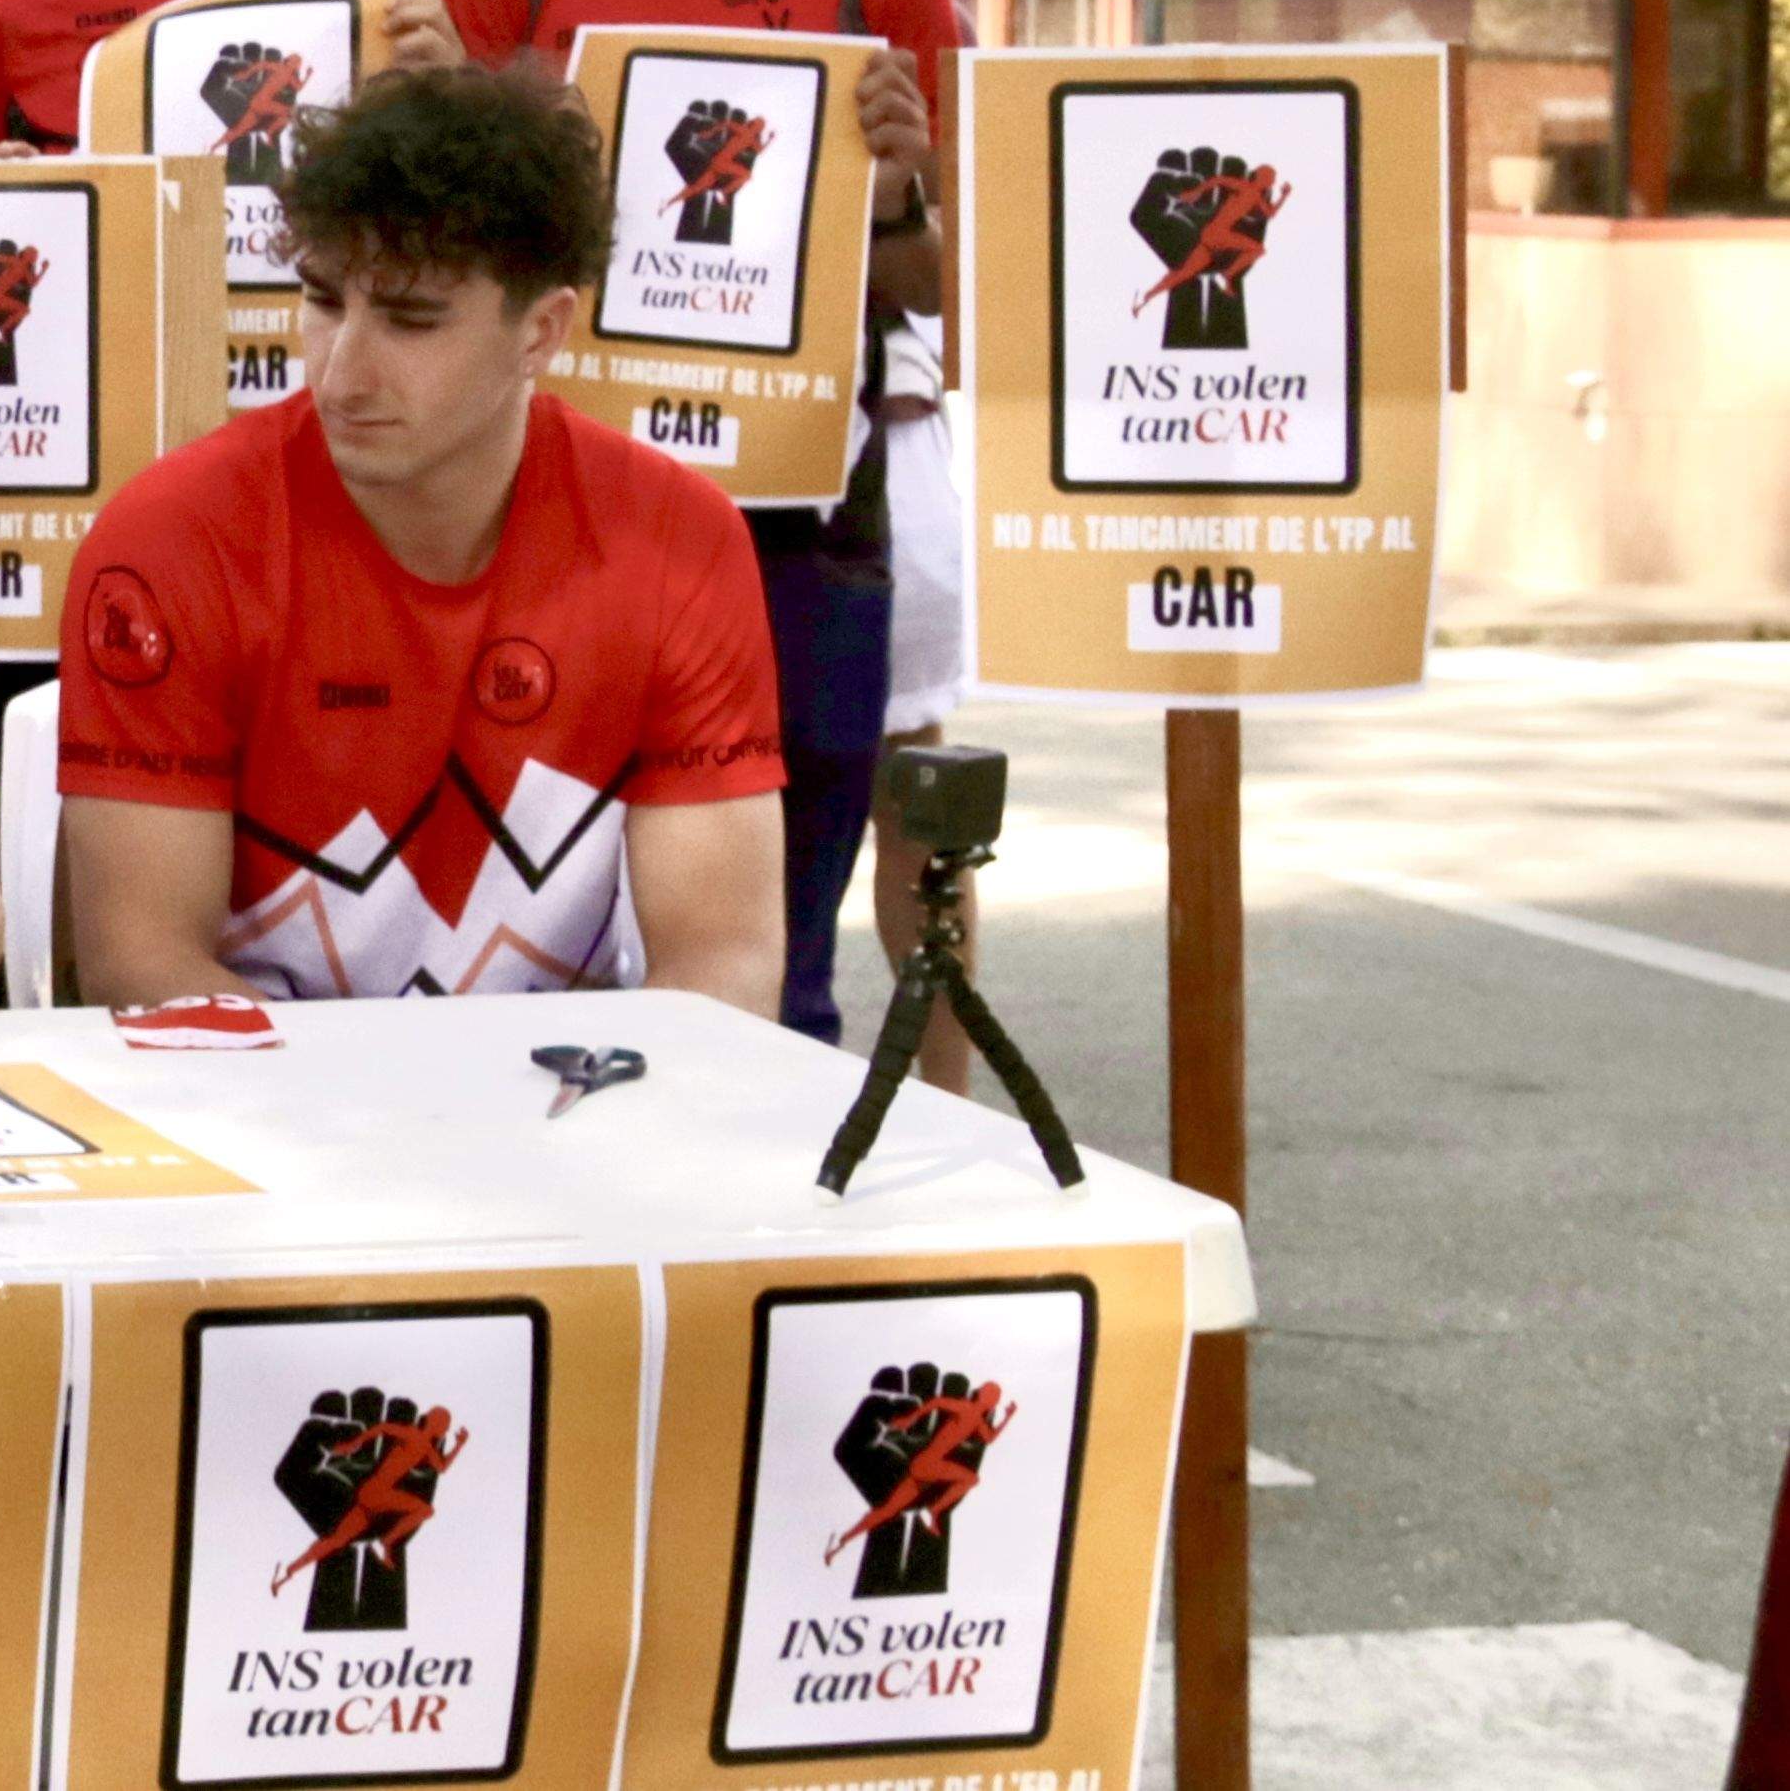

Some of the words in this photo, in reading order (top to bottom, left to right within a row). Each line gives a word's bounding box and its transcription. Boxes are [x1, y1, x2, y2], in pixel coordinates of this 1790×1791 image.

[632, 249, 684, 277] INS
[693, 253, 768, 286] volen
[641, 284, 754, 316] tanCAR
[1103, 364, 1179, 402] INS
[1193, 364, 1307, 401] volen
[649, 396, 722, 448] CAR
[1121, 407, 1289, 444] tanCAR
[31, 511, 59, 540] DE
[993, 514, 1033, 550] NO
[1041, 515, 1077, 553] AL
[1086, 515, 1262, 553] TANCAMENT
[1269, 515, 1306, 553] DE
[1382, 514, 1416, 552] AL
[1151, 565, 1256, 629] CAR
[778, 1614, 871, 1661] INS
[878, 1610, 1006, 1656] volen
[227, 1649, 324, 1694] INS
[337, 1646, 474, 1689] volen
[793, 1657, 982, 1705] tanCAR
[247, 1694, 448, 1739] tanCAR
